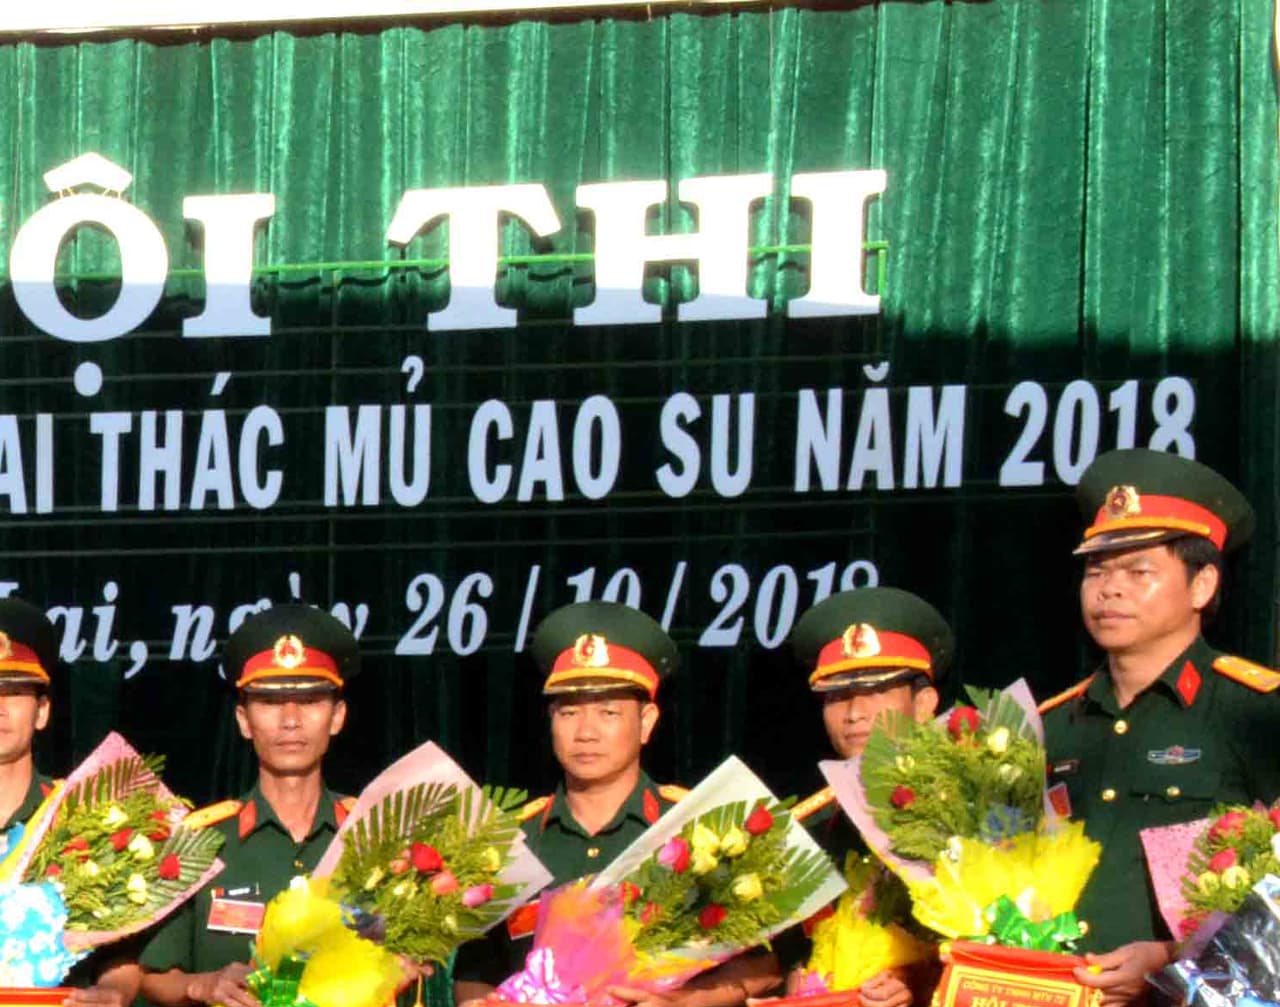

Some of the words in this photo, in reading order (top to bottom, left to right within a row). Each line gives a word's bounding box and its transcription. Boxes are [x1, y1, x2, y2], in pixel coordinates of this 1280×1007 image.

[387, 169, 886, 331] THI
[90, 372, 284, 512] THÁC
[324, 355, 432, 507] MỦ
[467, 394, 621, 504] CAO
[655, 392, 755, 499] SU
[793, 361, 966, 492] NĂM
[999, 376, 1195, 487] 2018
[395, 572, 493, 656] 26
